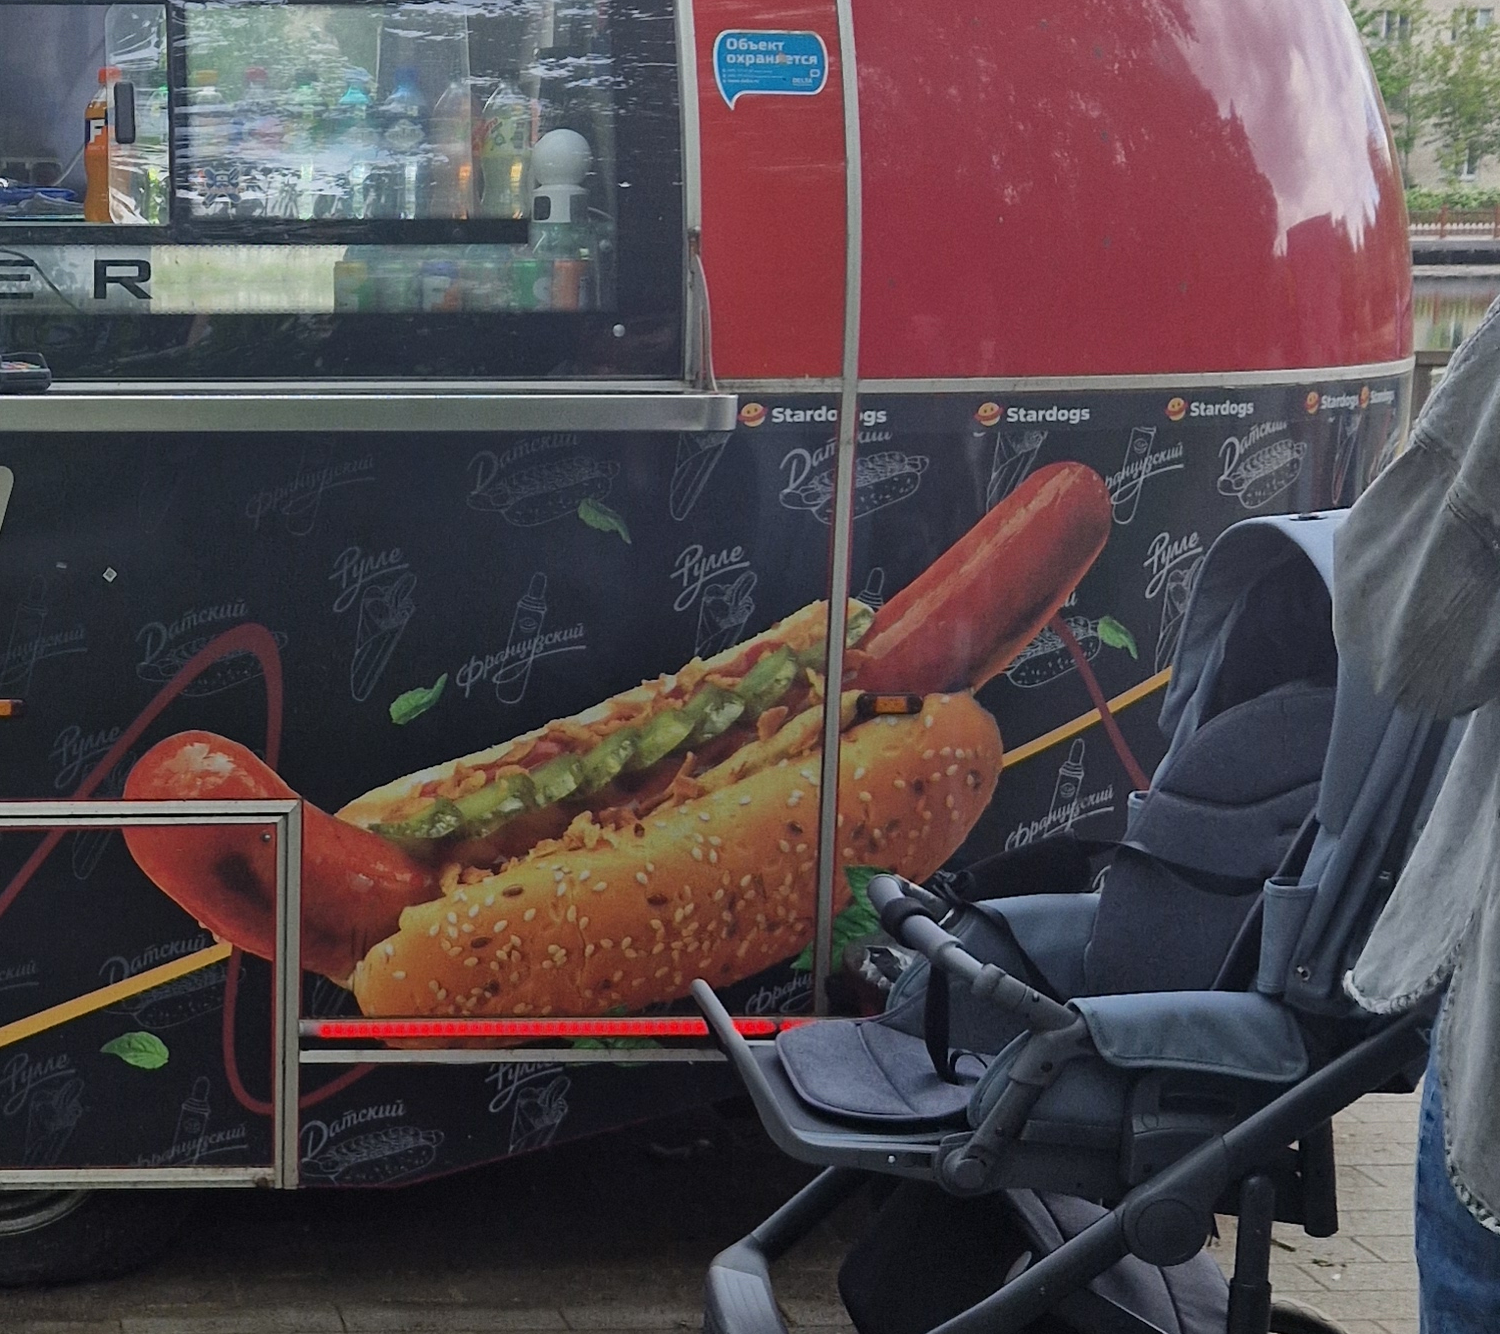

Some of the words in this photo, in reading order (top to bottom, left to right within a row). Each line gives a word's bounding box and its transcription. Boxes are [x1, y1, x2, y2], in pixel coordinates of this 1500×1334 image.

[726, 38, 785, 51] Объект
[1006, 406, 1090, 424] Stardogs
[1189, 400, 1254, 418] Stardogs
[329, 545, 410, 614] Рулле
[669, 544, 750, 613] Рулле
[1143, 531, 1203, 599] Рулле
[135, 597, 250, 666] Датский
[456, 621, 588, 699] Французский
[299, 1098, 406, 1158] Датский
